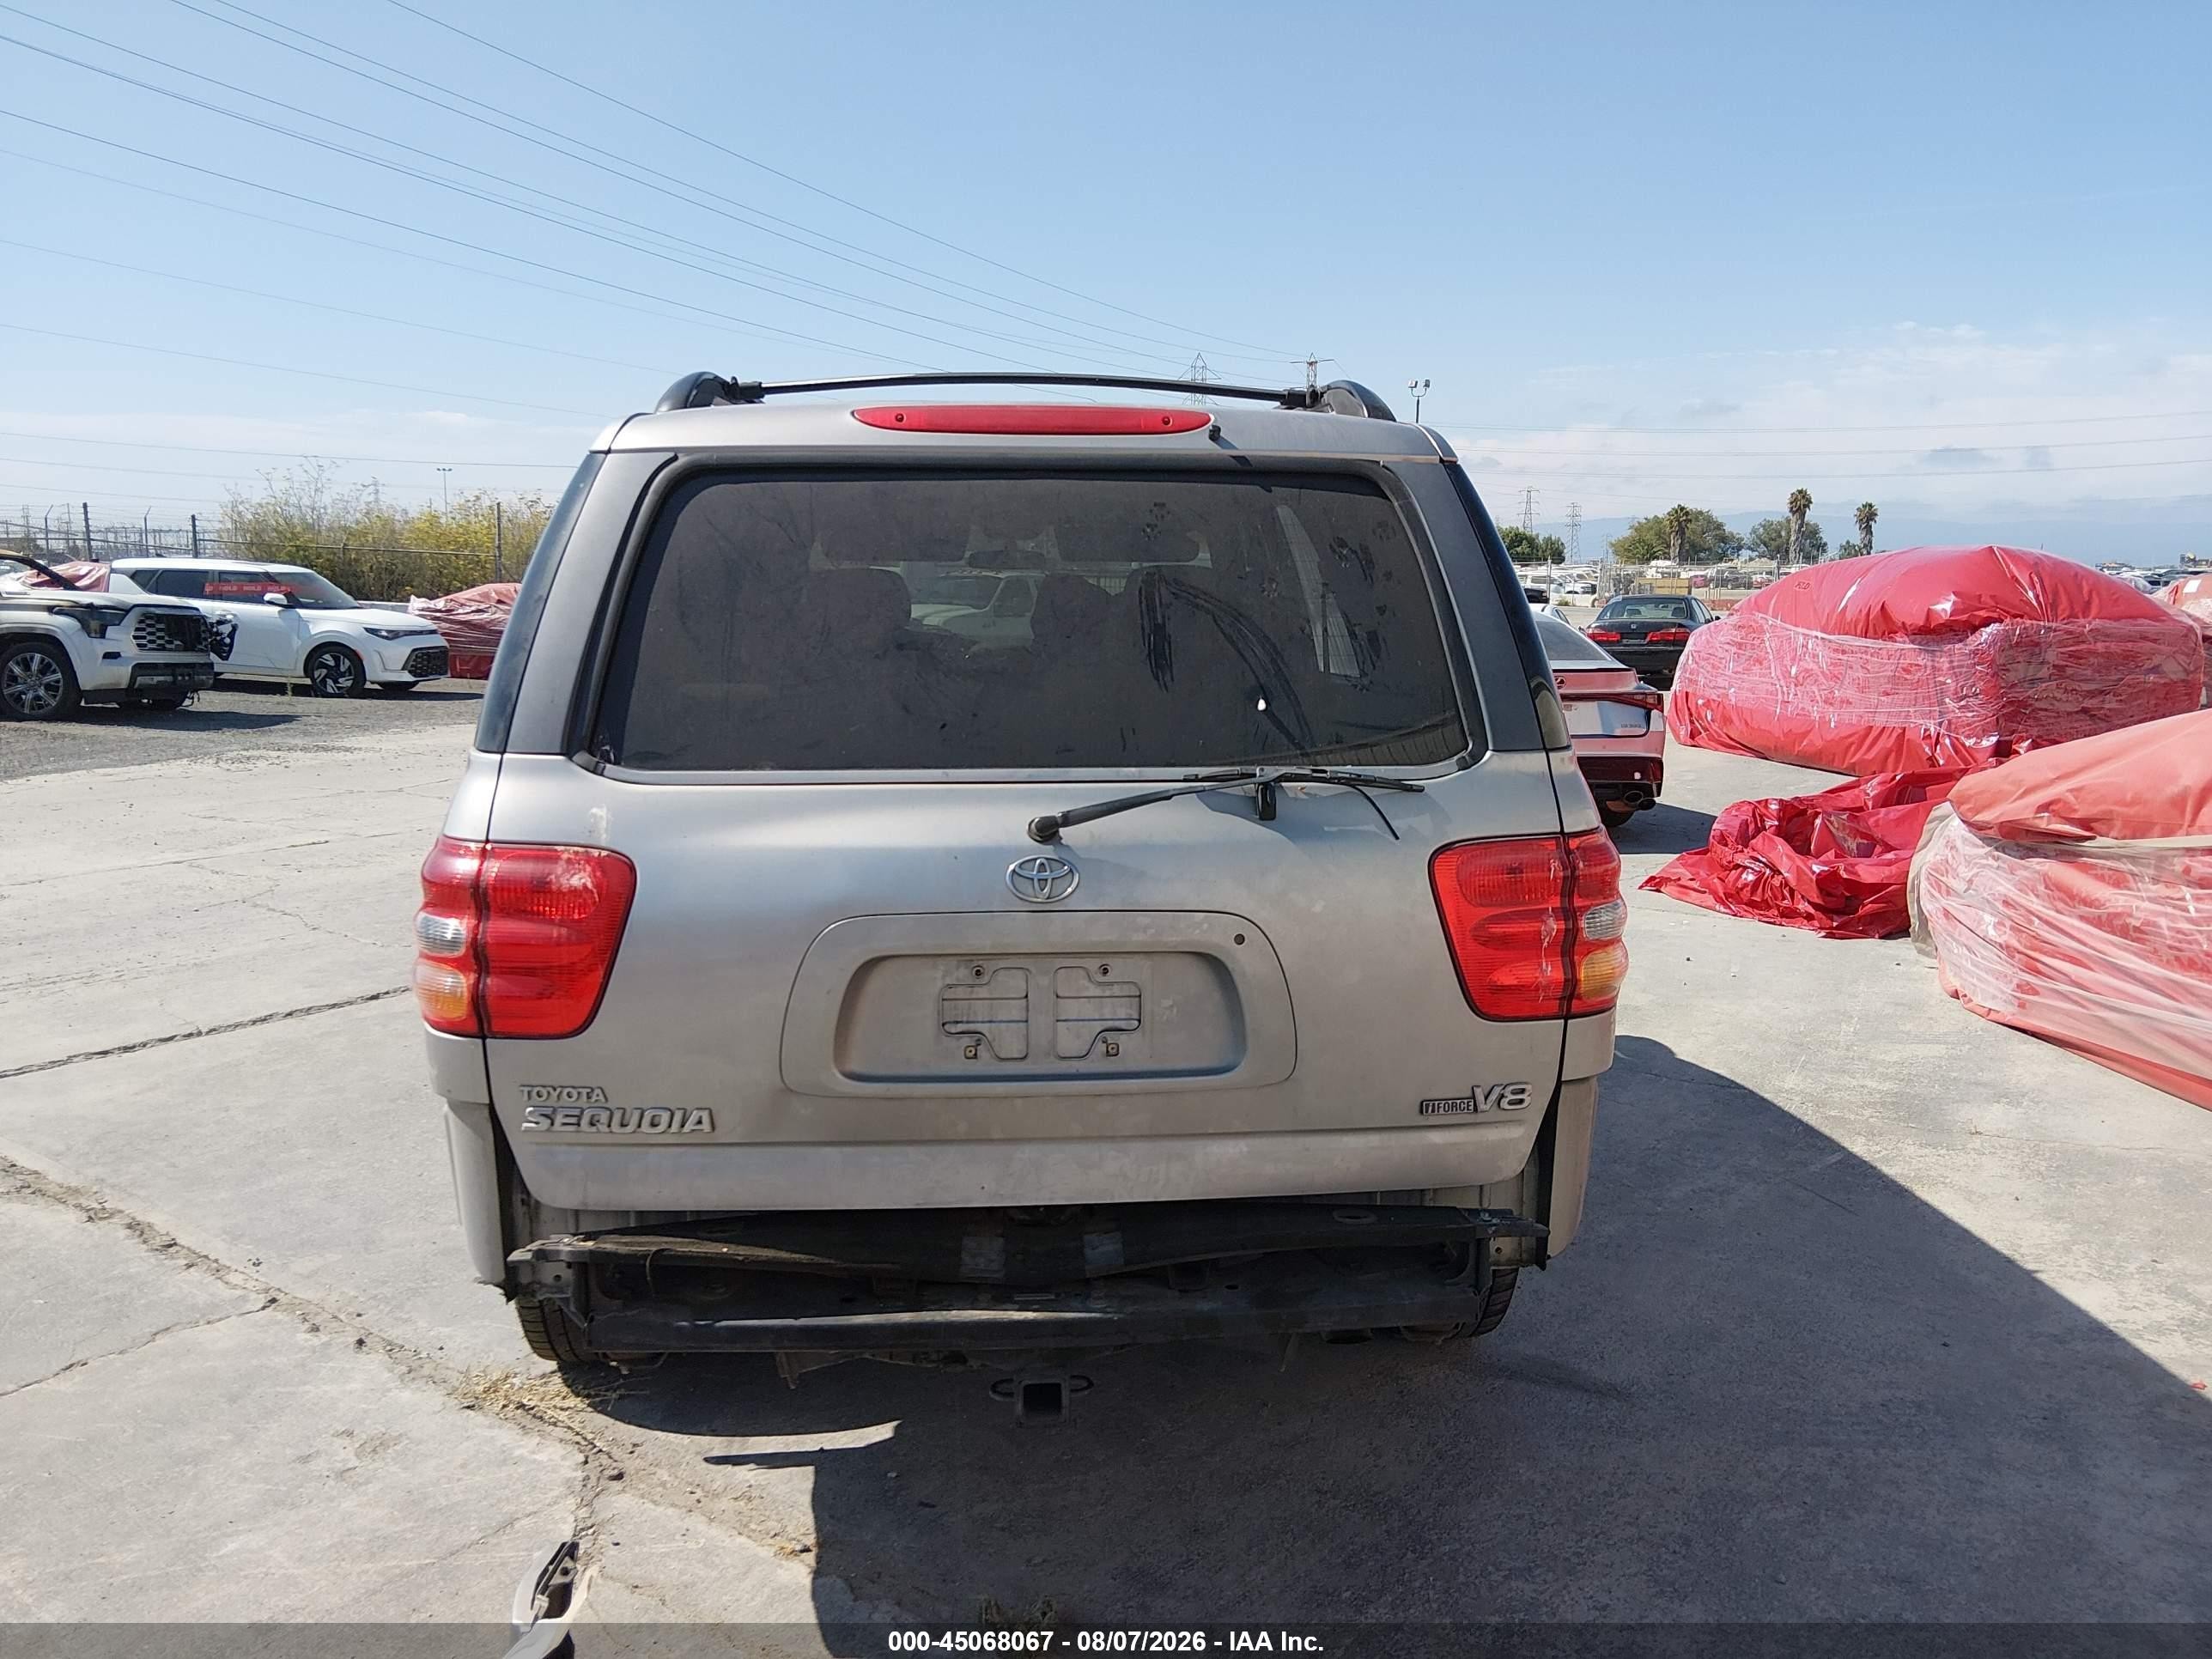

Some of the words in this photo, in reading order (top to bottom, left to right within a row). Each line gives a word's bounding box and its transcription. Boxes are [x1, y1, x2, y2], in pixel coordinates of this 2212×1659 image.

[520, 1085, 607, 1103] TOYOTA
[1472, 1082, 1532, 1113] V8
[521, 1106, 714, 1134] SEQUOIA
